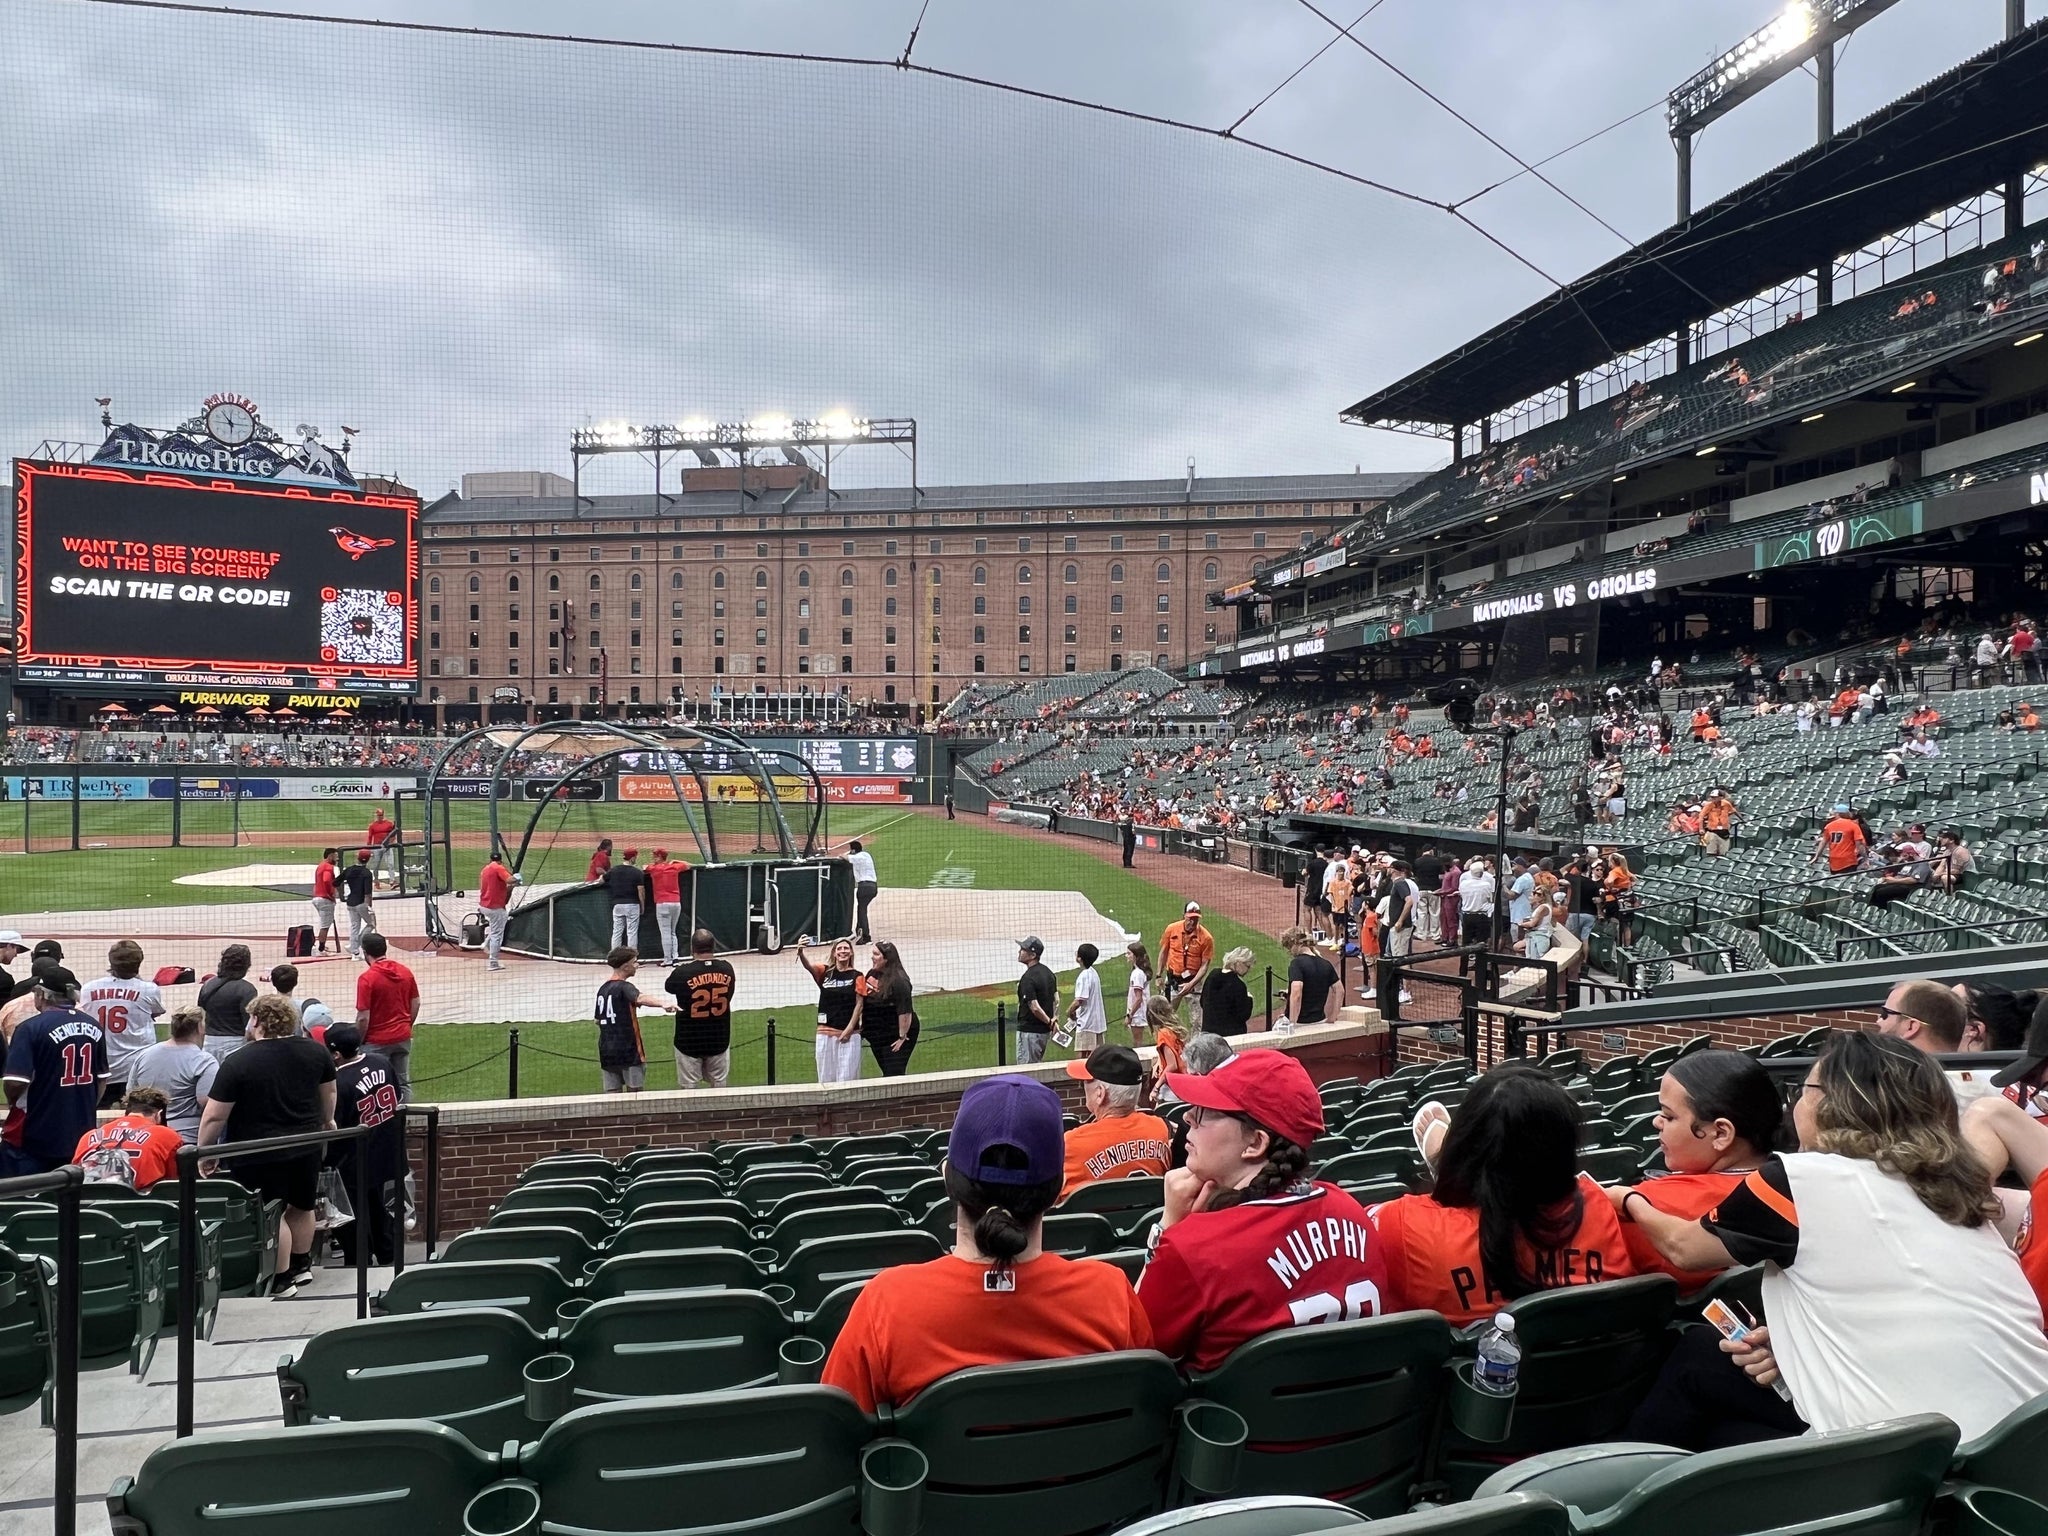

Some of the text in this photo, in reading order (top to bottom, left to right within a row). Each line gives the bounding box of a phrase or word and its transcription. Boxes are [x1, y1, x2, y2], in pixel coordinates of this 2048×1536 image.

[213, 449, 273, 476] Price
[62, 537, 281, 566] WANT TO SEE YOURSELF
[79, 553, 270, 580] ON THE BIG SCREEN?
[49, 576, 291, 607] SCAN THE QR CODE!
[1473, 568, 1656, 622] NATIONALS VS ORIOLES
[1240, 639, 1324, 668] NATIONALS VS ORIOLES
[165, 674, 199, 683] ORIOLE
[199, 675, 222, 684] PARK
[230, 677, 266, 686] CAMDEN
[266, 677, 294, 686] YARDS
[180, 692, 361, 709] PUREWAGER PAVILION
[180, 789, 219, 798] MedStar
[329, 785, 373, 793] RANKIN
[448, 784, 478, 793] TRUIST
[90, 988, 140, 1002] MANCINI
[687, 972, 731, 990] SANTANDER
[597, 994, 617, 1025] 24
[691, 986, 728, 1018] 25
[49, 1022, 103, 1044] HENDERSON
[97, 1005, 128, 1034] 16
[60, 1042, 93, 1087] 11
[355, 1069, 385, 1095] WOOD
[356, 1084, 398, 1128] 29
[1267, 1217, 1367, 1290] MURPHY
[1450, 1248, 1603, 1311] PAMER
